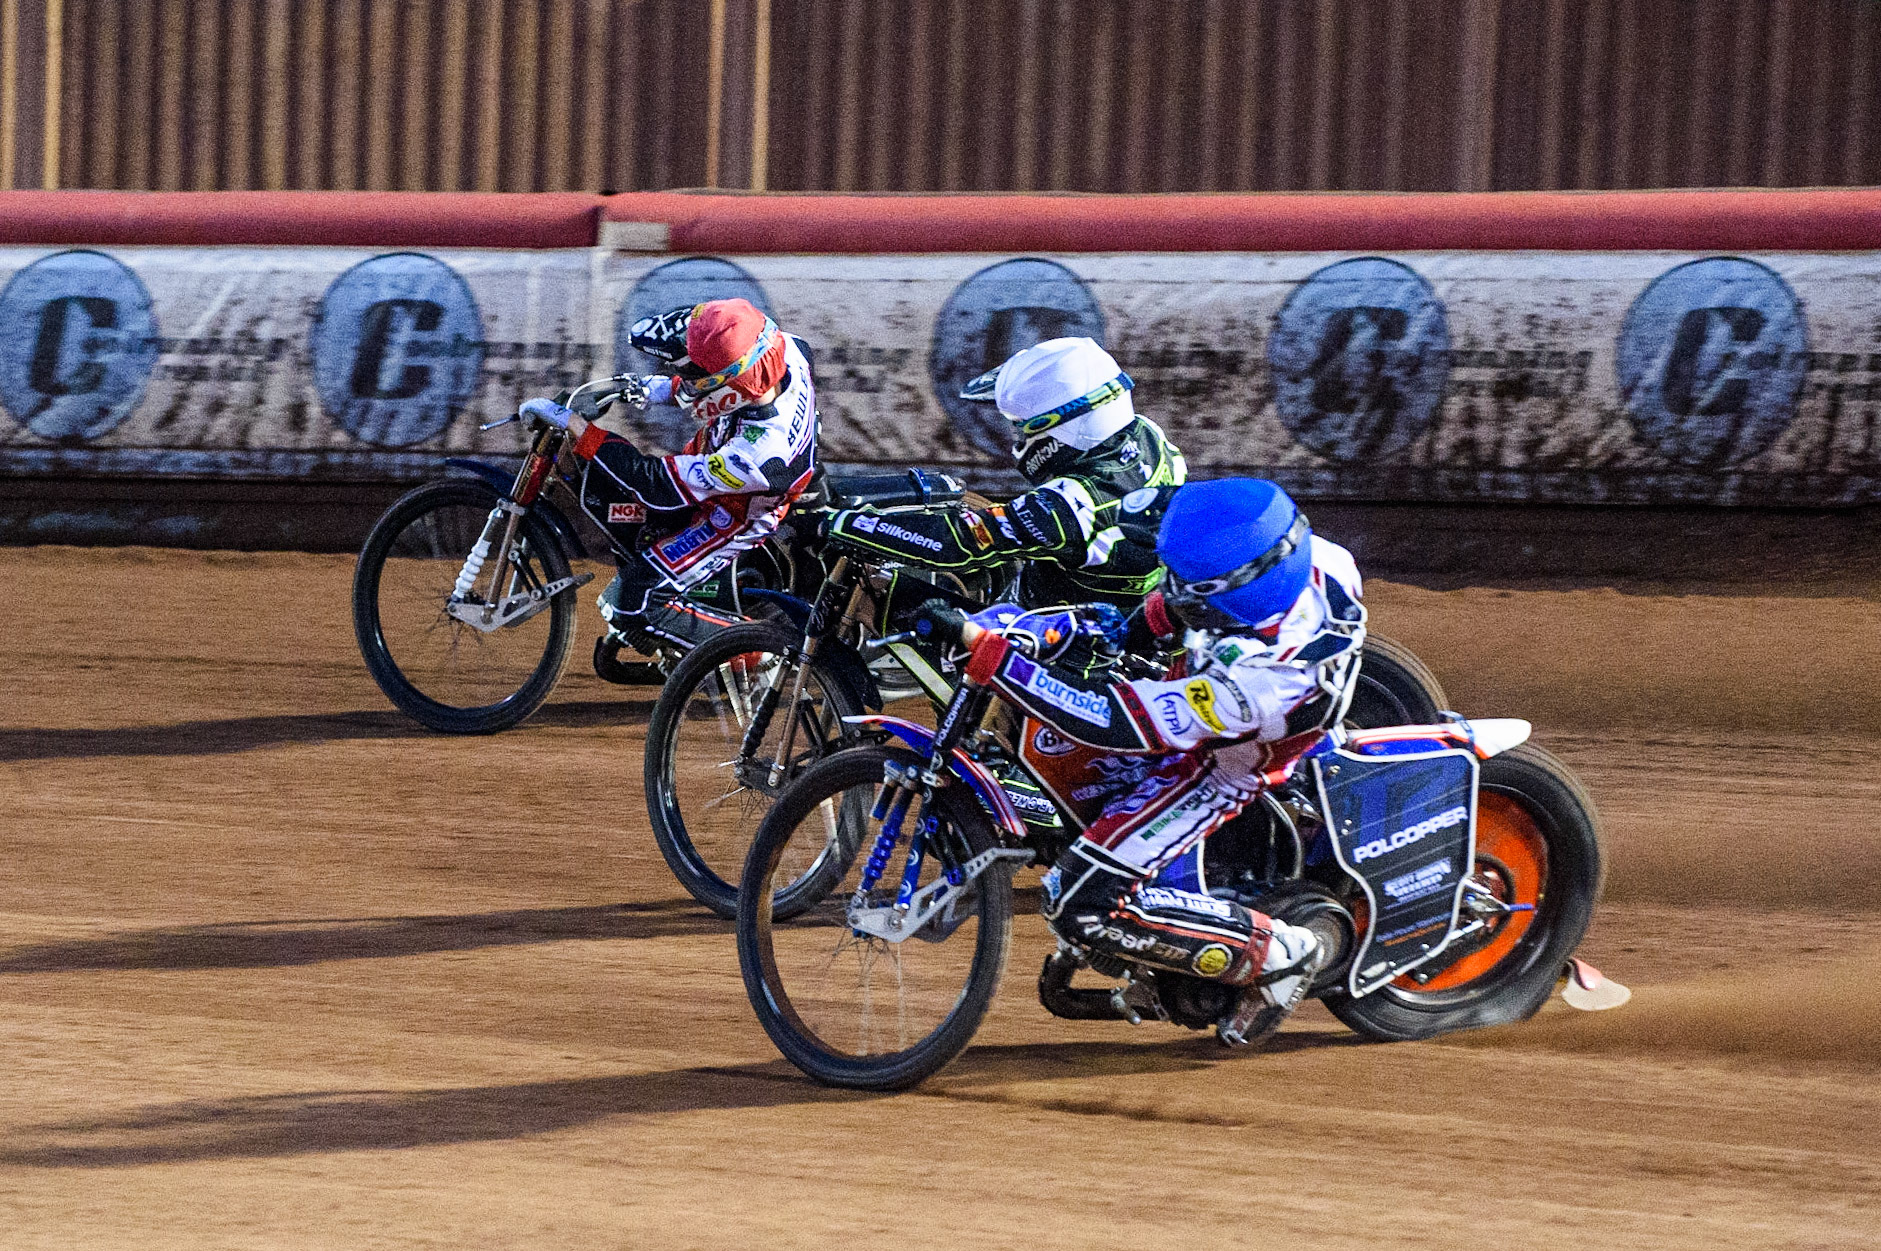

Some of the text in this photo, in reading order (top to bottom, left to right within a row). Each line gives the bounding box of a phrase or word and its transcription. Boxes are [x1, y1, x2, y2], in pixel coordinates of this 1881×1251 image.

[611, 504, 644, 517] NGK
[1034, 667, 1112, 721] burnside
[1351, 805, 1469, 864] POLCOPPER
